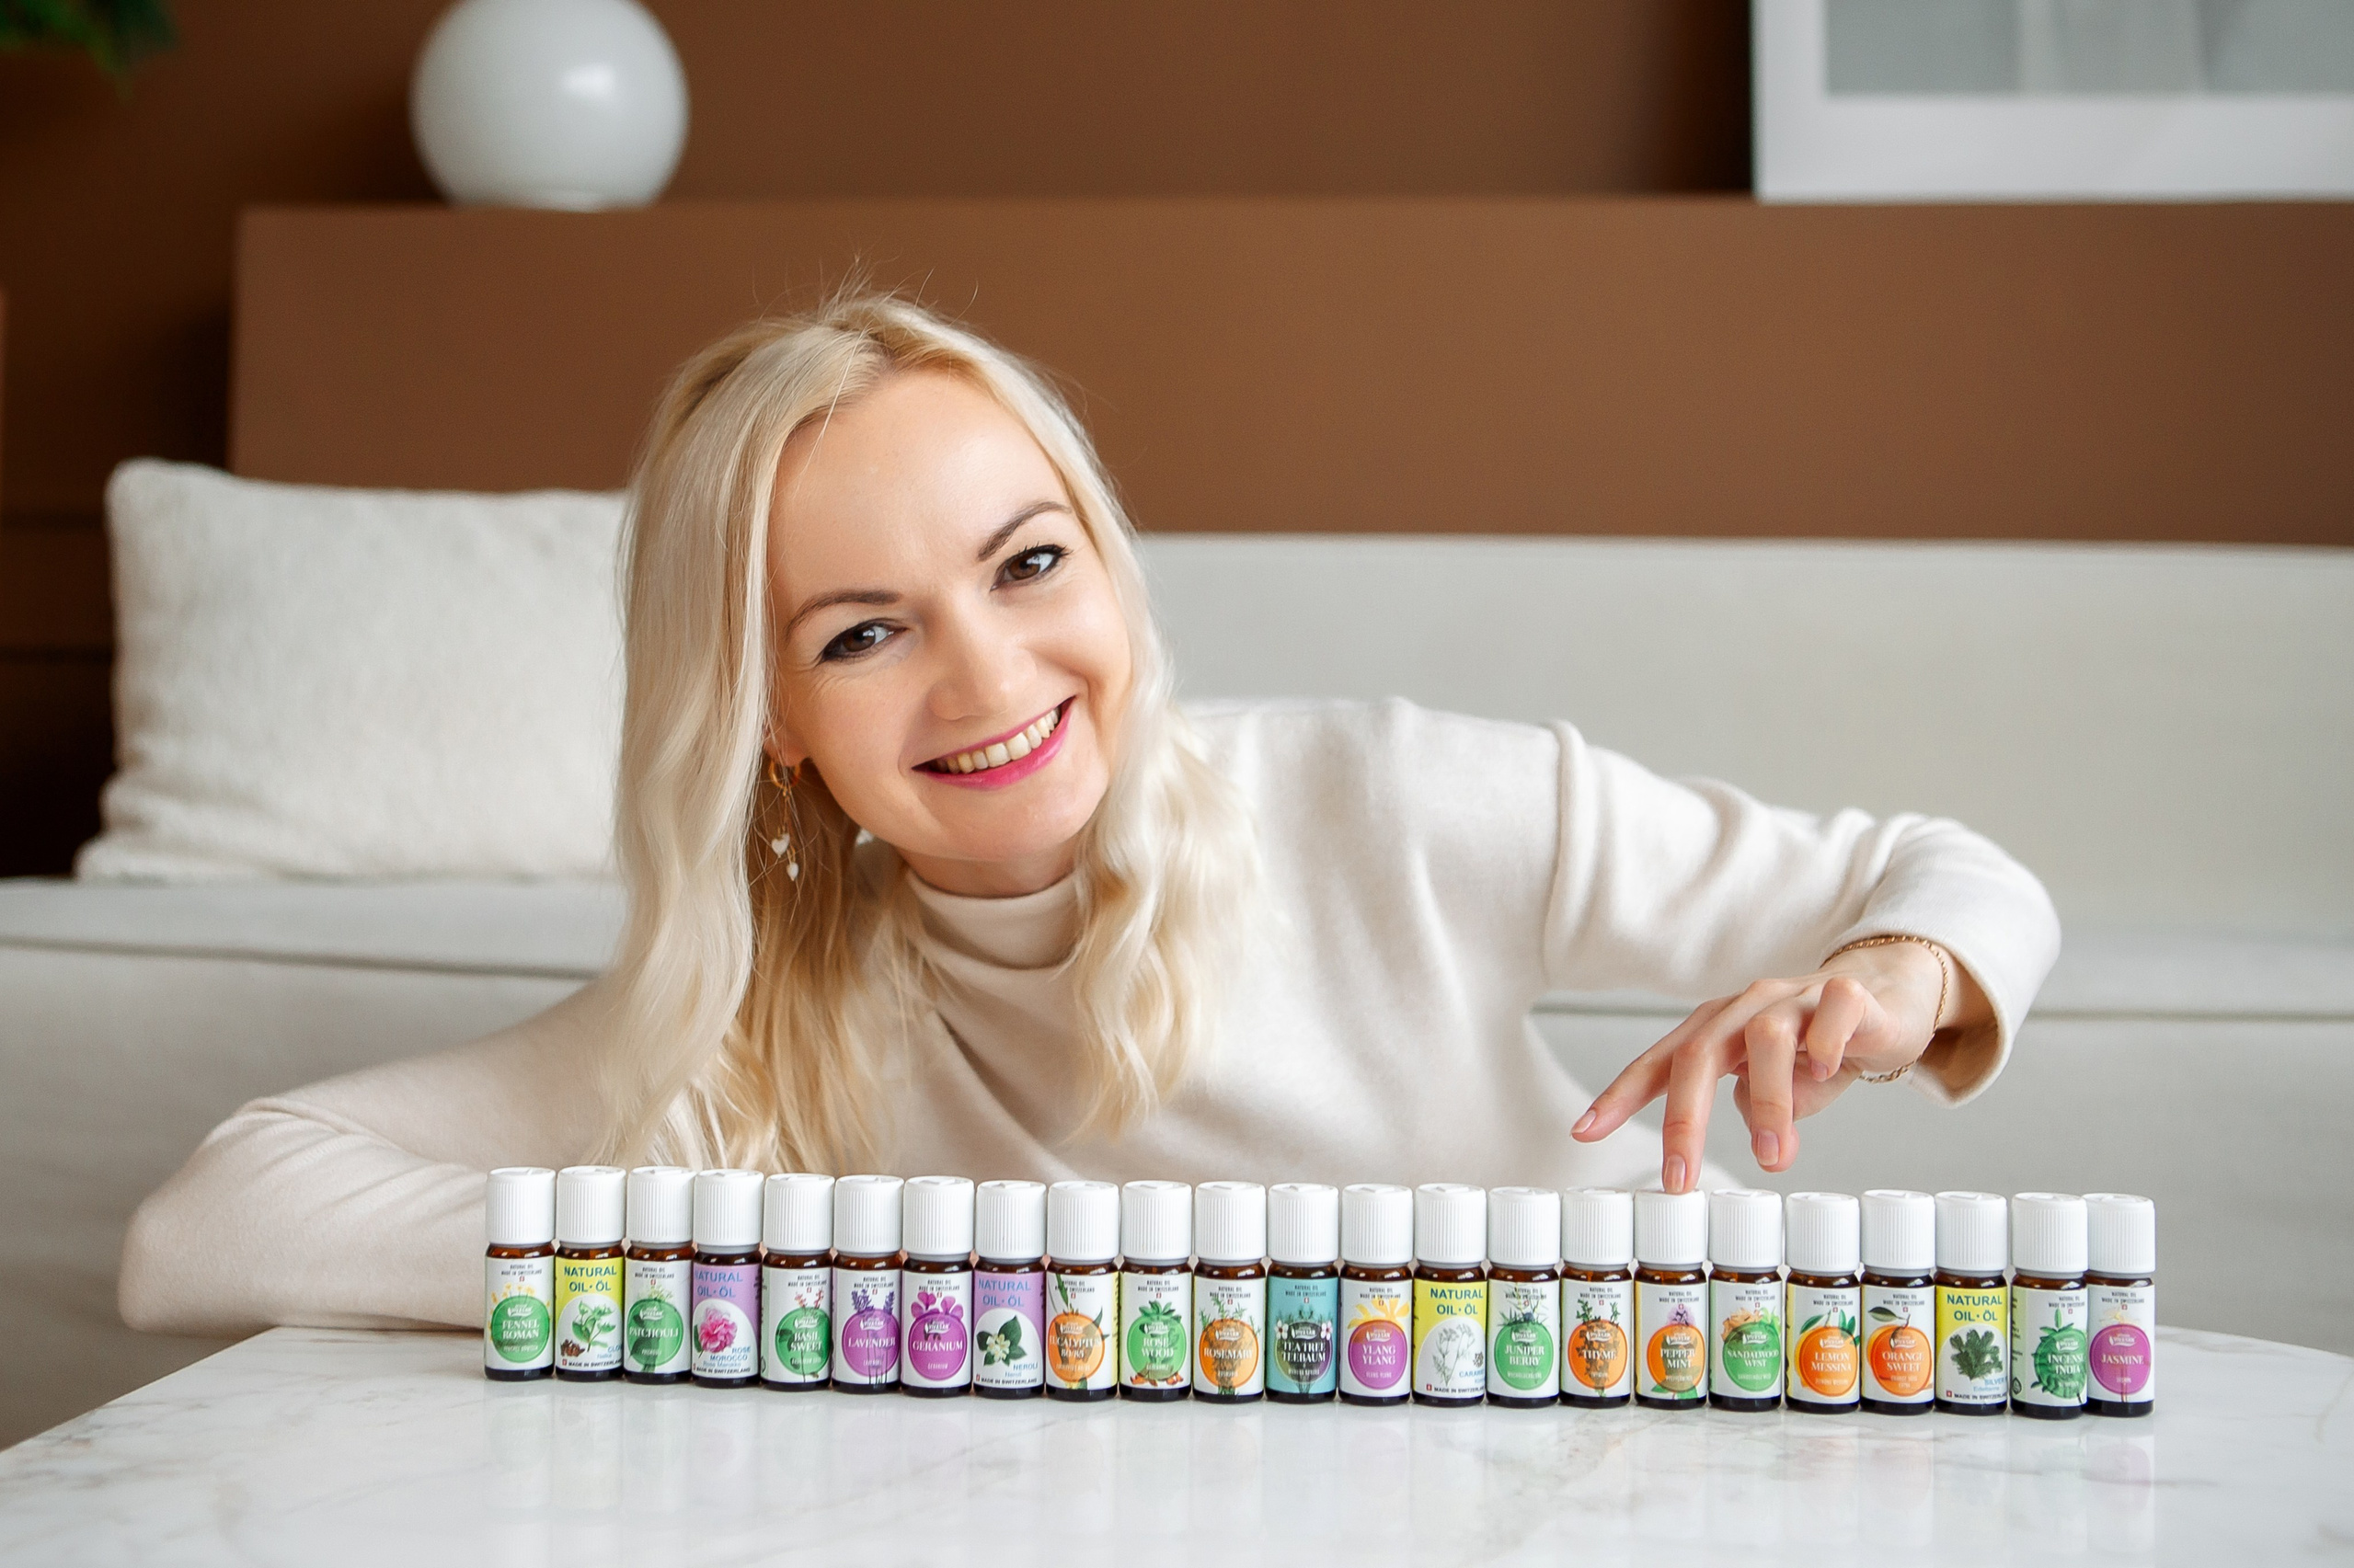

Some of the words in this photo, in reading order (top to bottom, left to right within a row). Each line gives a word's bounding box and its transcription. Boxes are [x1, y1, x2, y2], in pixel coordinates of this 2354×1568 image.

[564, 1266, 616, 1277] NATURAL
[569, 1282, 588, 1292] OIL
[596, 1280, 611, 1291] ÖL
[978, 1279, 1031, 1291] NATURAL
[697, 1287, 712, 1297] OIL
[719, 1287, 736, 1298] ÖL
[1430, 1288, 1483, 1299] NATURAL
[983, 1296, 1001, 1305] OIL
[1008, 1296, 1024, 1307] ÖL
[1947, 1294, 2003, 1306] NATURAL
[1437, 1305, 1456, 1315] OIL
[1464, 1304, 1477, 1315] ÖL
[1954, 1310, 1975, 1322] OIL
[1983, 1310, 1997, 1321] ÖL
[502, 1320, 540, 1329] FENNEL
[503, 1330, 538, 1339] ROMAN
[629, 1326, 679, 1337] PATCHOULI
[794, 1332, 818, 1341] BASIL
[790, 1342, 822, 1352] SWEET
[848, 1337, 895, 1348] LAVENDER
[913, 1341, 963, 1351] GERANIUM
[1143, 1338, 1169, 1346] ROSE
[608, 1344, 623, 1353] CLO
[1142, 1349, 1174, 1357] WOOD
[1204, 1348, 1252, 1359] ROSEMARY
[1362, 1345, 1395, 1355] YLANG
[1505, 1345, 1544, 1355] JUNIPER
[1660, 1349, 1695, 1357] PEPPER
[1282, 1353, 1326, 1362] TEEBAUM
[1583, 1350, 1616, 1359] THYME
[1815, 1353, 1849, 1361] LEMON
[1882, 1352, 1924, 1362] ORANGE
[2048, 1354, 2084, 1363] INCENSE
[1362, 1356, 1395, 1365] YLANG
[1510, 1356, 1541, 1366] BERRY
[1667, 1359, 1692, 1368] MINT
[2101, 1355, 2143, 1365] JASMINE
[1014, 1362, 1038, 1370] NEROLI
[1811, 1362, 1852, 1371] MESSINA
[1887, 1363, 1921, 1371] SWEET
[2055, 1365, 2080, 1374] INDIA
